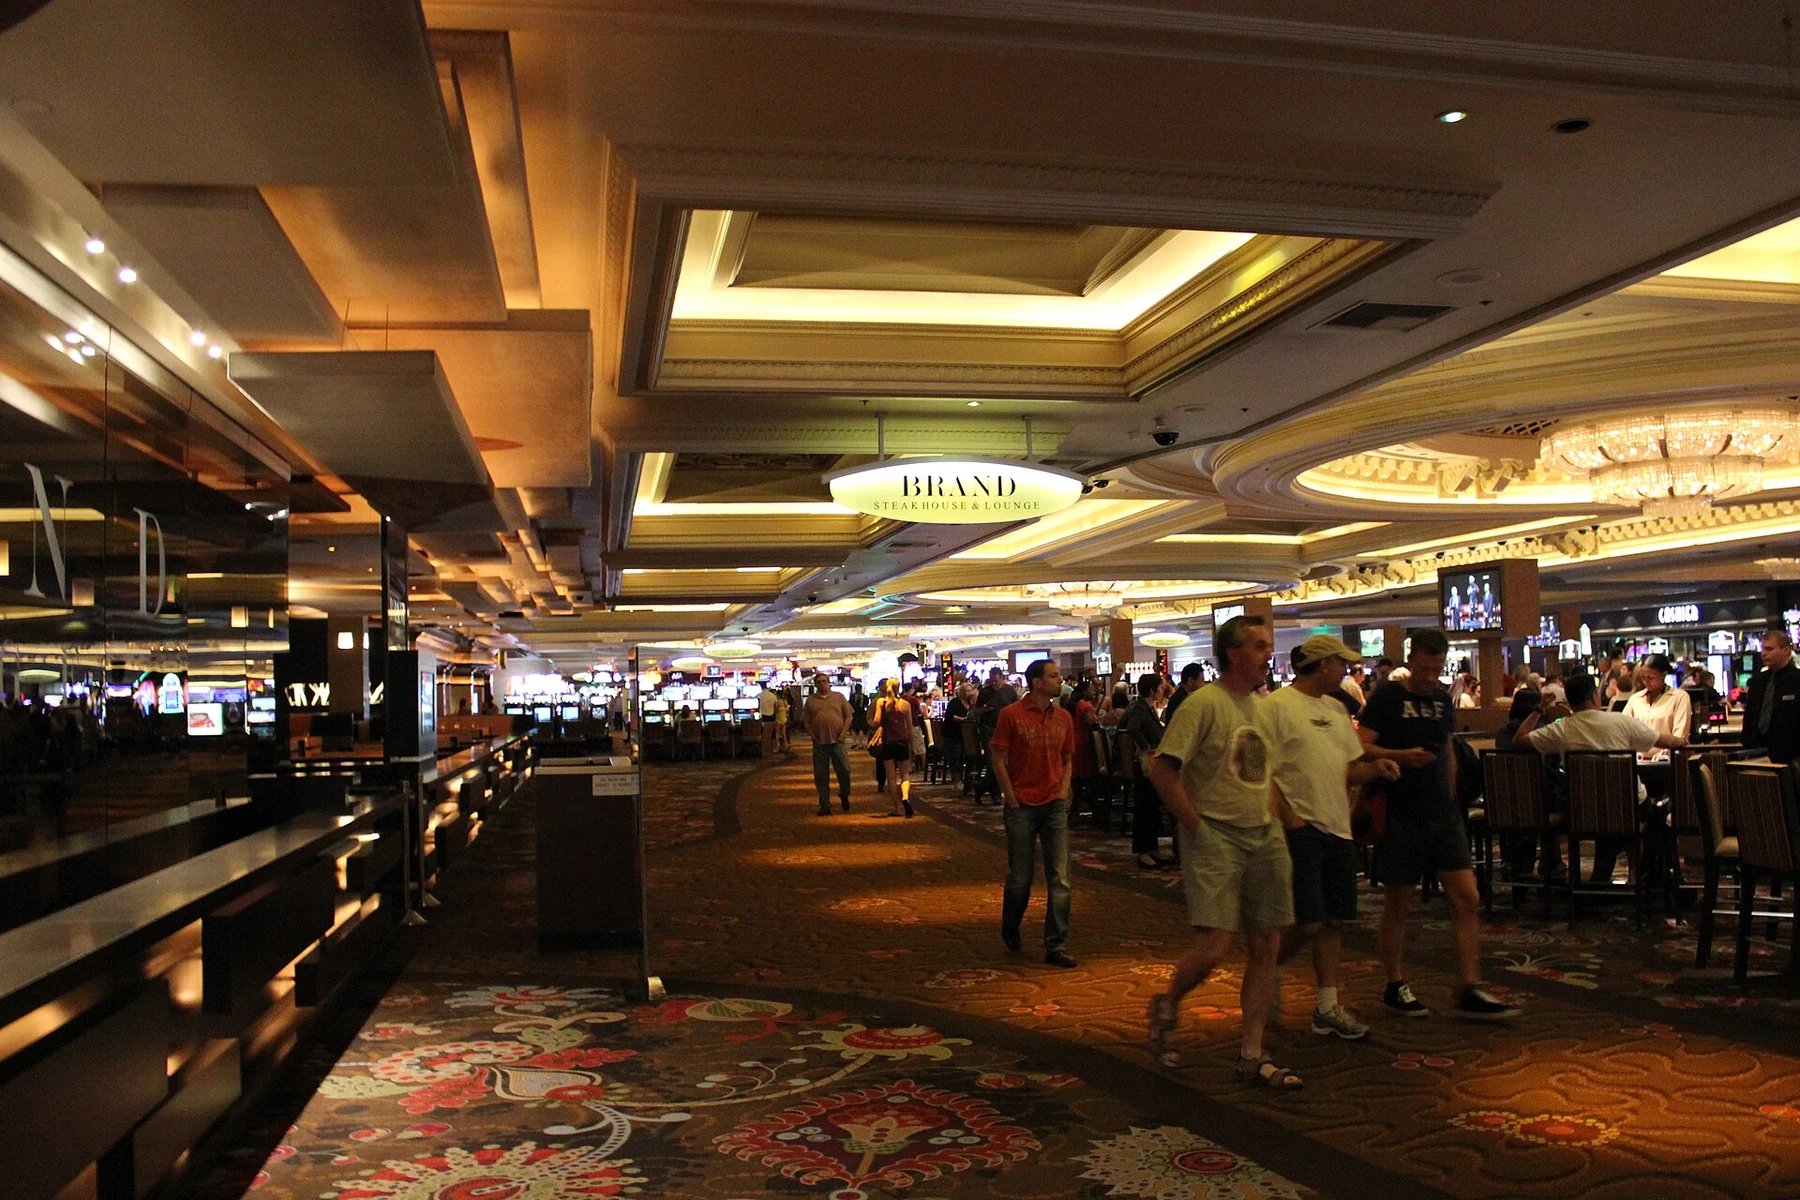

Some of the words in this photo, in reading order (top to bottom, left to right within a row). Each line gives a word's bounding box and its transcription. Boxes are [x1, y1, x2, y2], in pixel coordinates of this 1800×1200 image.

[901, 475, 1016, 497] BRAND
[873, 501, 967, 510] STEAKHOUSE
[971, 502, 980, 510] &
[985, 501, 1040, 510] LOUNGE
